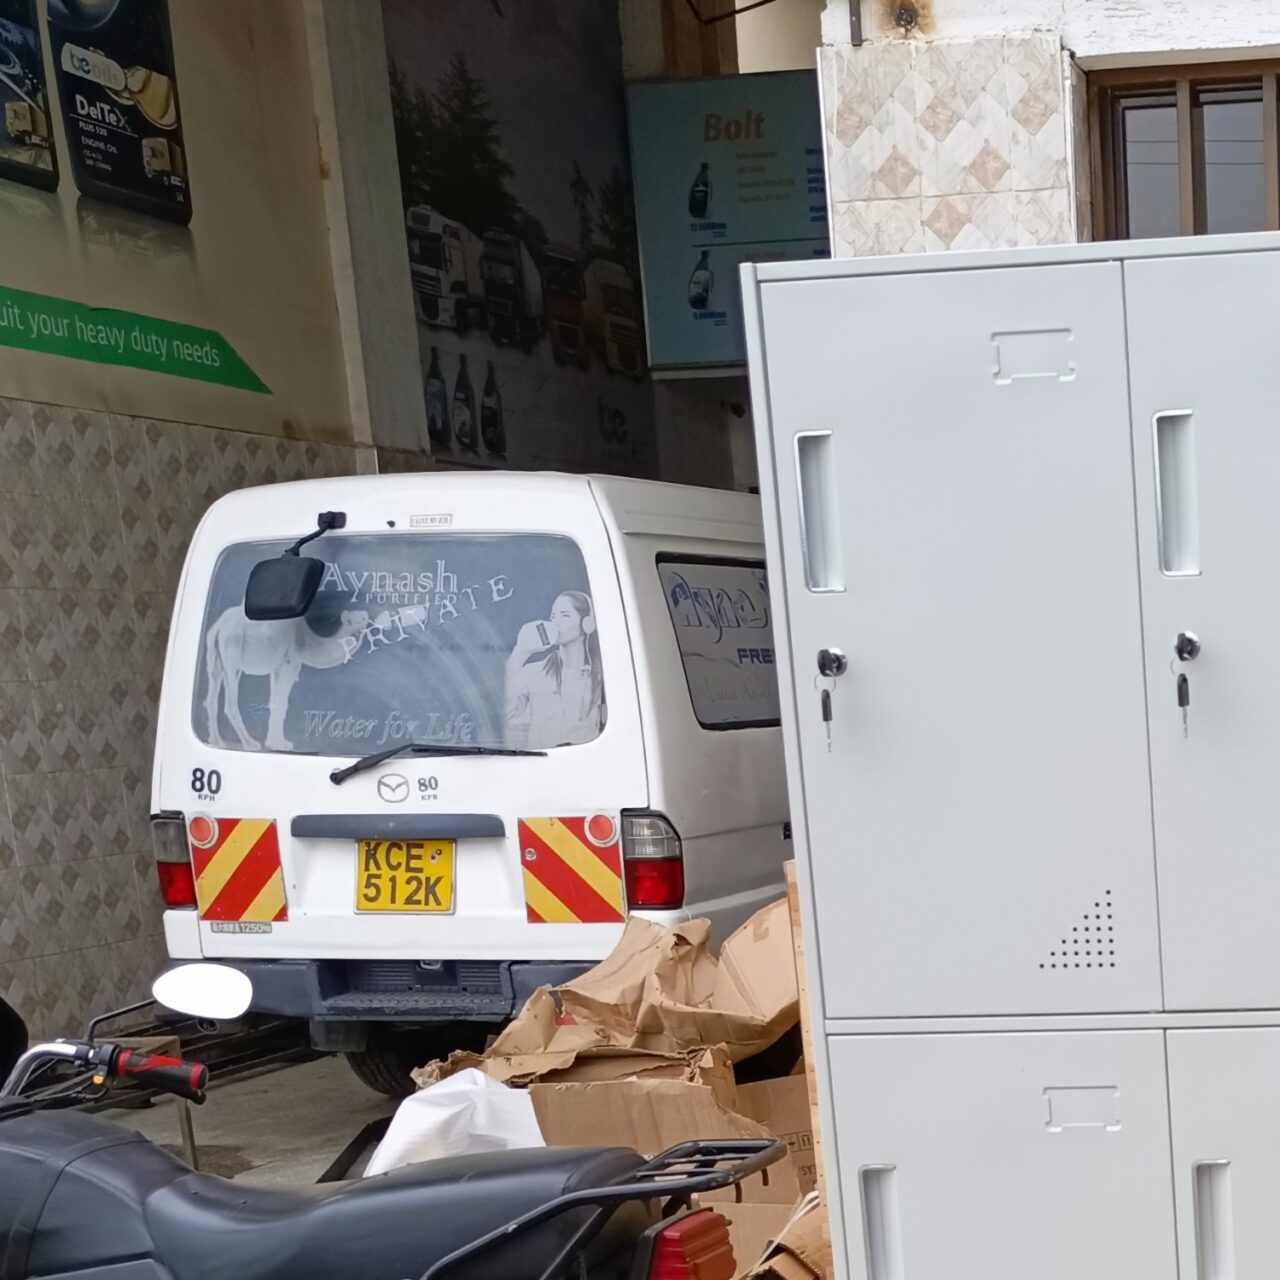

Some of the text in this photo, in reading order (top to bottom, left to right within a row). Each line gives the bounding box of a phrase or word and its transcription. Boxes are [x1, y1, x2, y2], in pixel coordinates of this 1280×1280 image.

[703, 109, 766, 143] Bolt
[27, 311, 70, 339] your
[75, 314, 125, 353] heavy
[131, 326, 168, 361] duty
[172, 340, 220, 367] needs
[318, 560, 459, 603] Aynash
[337, 574, 515, 665] PRIVATE
[736, 647, 775, 665] FRE
[302, 709, 475, 746] Water for Life
[191, 767, 222, 795] 80
[197, 793, 216, 802] KPH
[417, 776, 439, 792] 80
[420, 793, 438, 801] KPH
[364, 841, 425, 874] KCE
[362, 873, 444, 906] 512K
